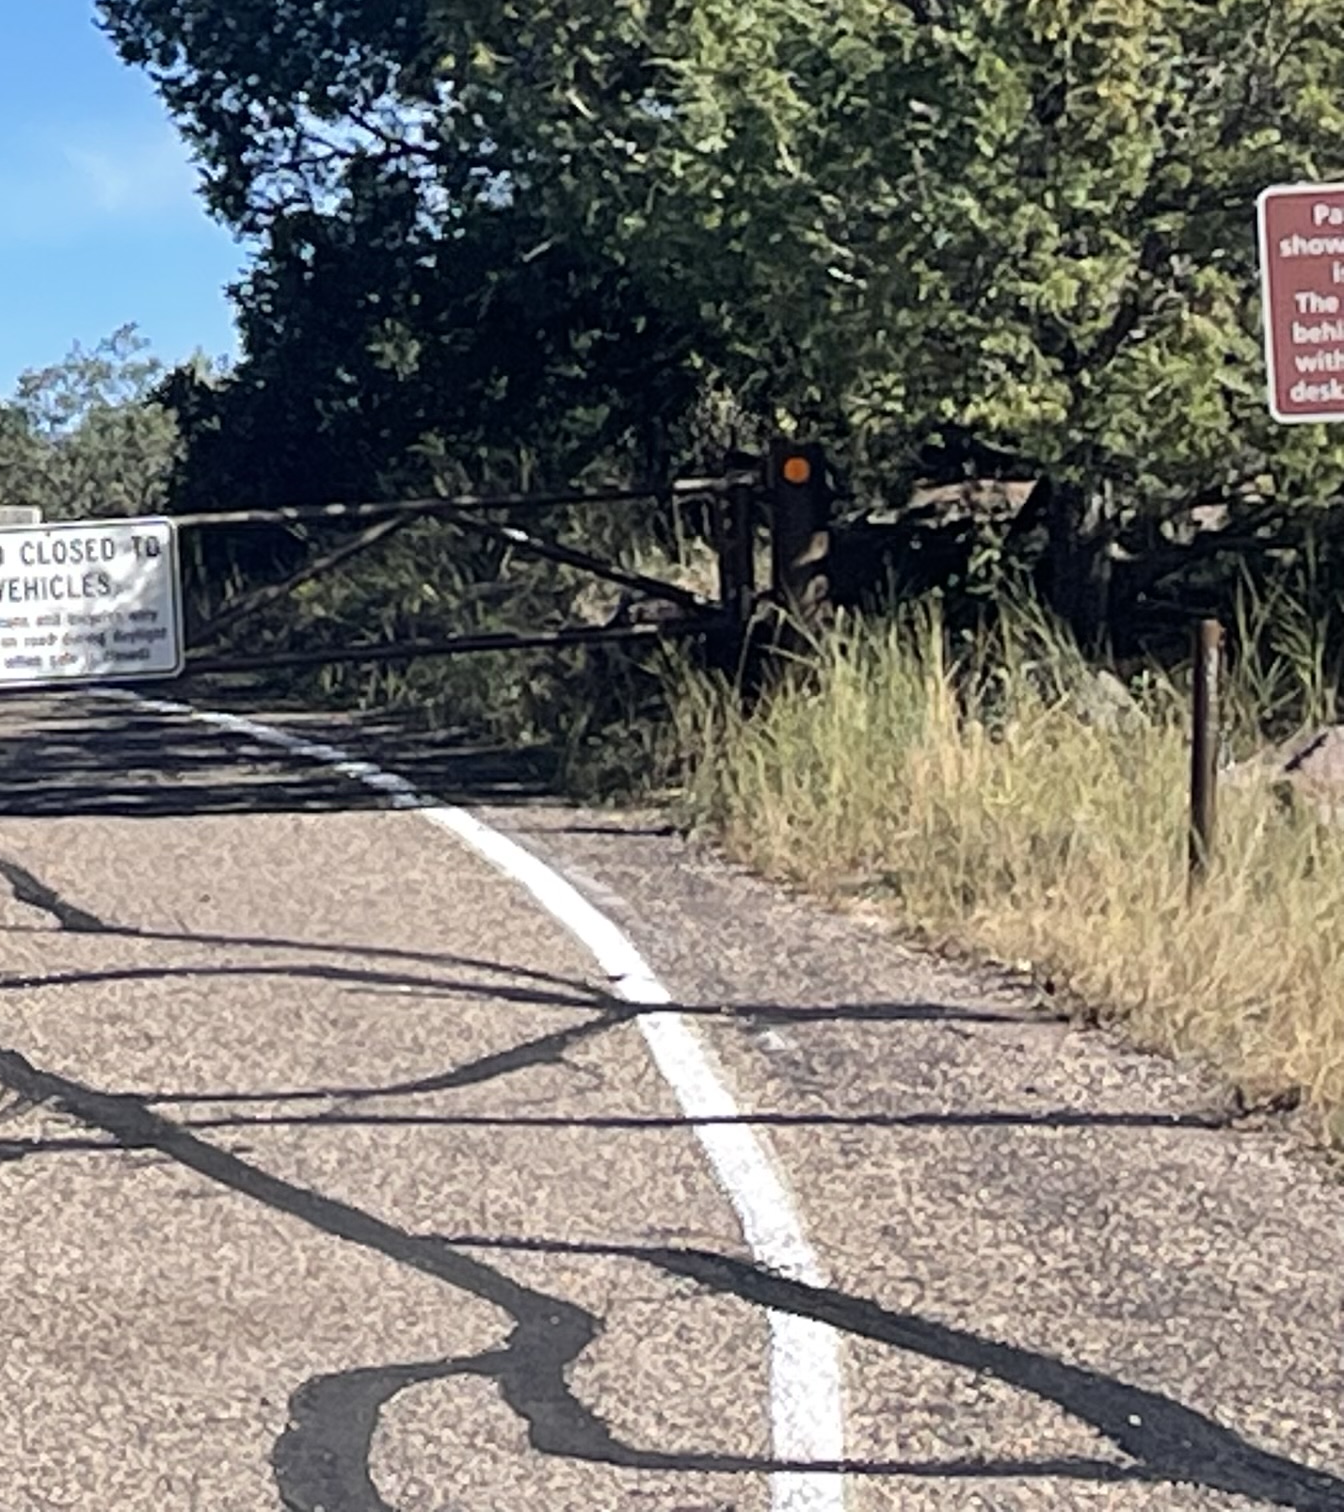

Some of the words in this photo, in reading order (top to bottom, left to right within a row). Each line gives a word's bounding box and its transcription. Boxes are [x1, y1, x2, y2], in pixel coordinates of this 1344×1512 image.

[1313, 203, 1344, 226] Pa
[1279, 233, 1344, 258] show
[1295, 291, 1340, 315] The
[1293, 319, 1344, 344] behi
[20, 538, 115, 566] CLOSED
[131, 535, 161, 558] TO
